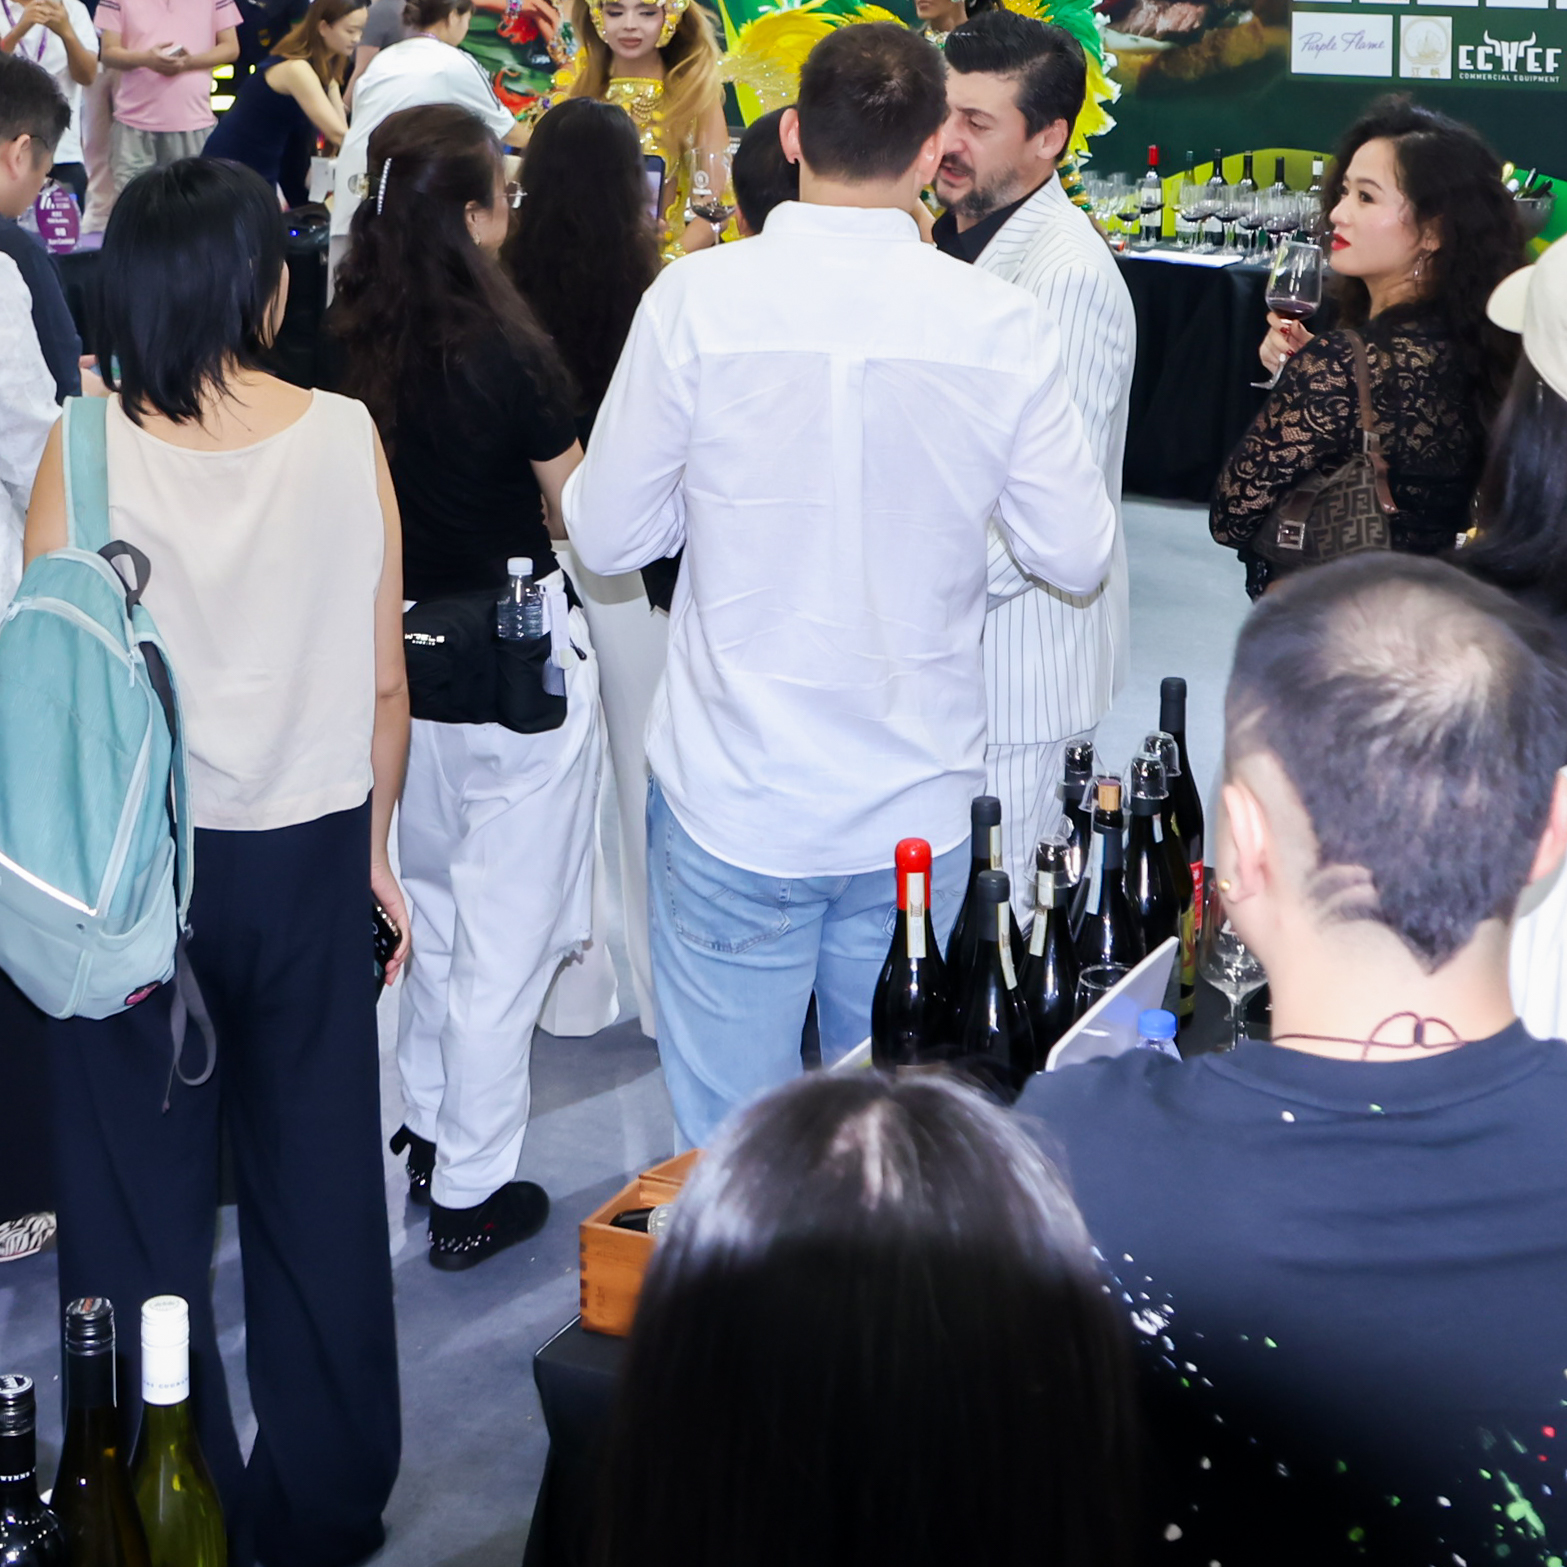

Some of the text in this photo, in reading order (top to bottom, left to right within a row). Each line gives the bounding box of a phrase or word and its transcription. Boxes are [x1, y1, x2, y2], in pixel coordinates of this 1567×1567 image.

[1299, 30, 1385, 59] Purple Flame
[1459, 30, 1562, 73] ECHEF
[1459, 72, 1561, 84] COMMERCIAL EQUIPMENT
